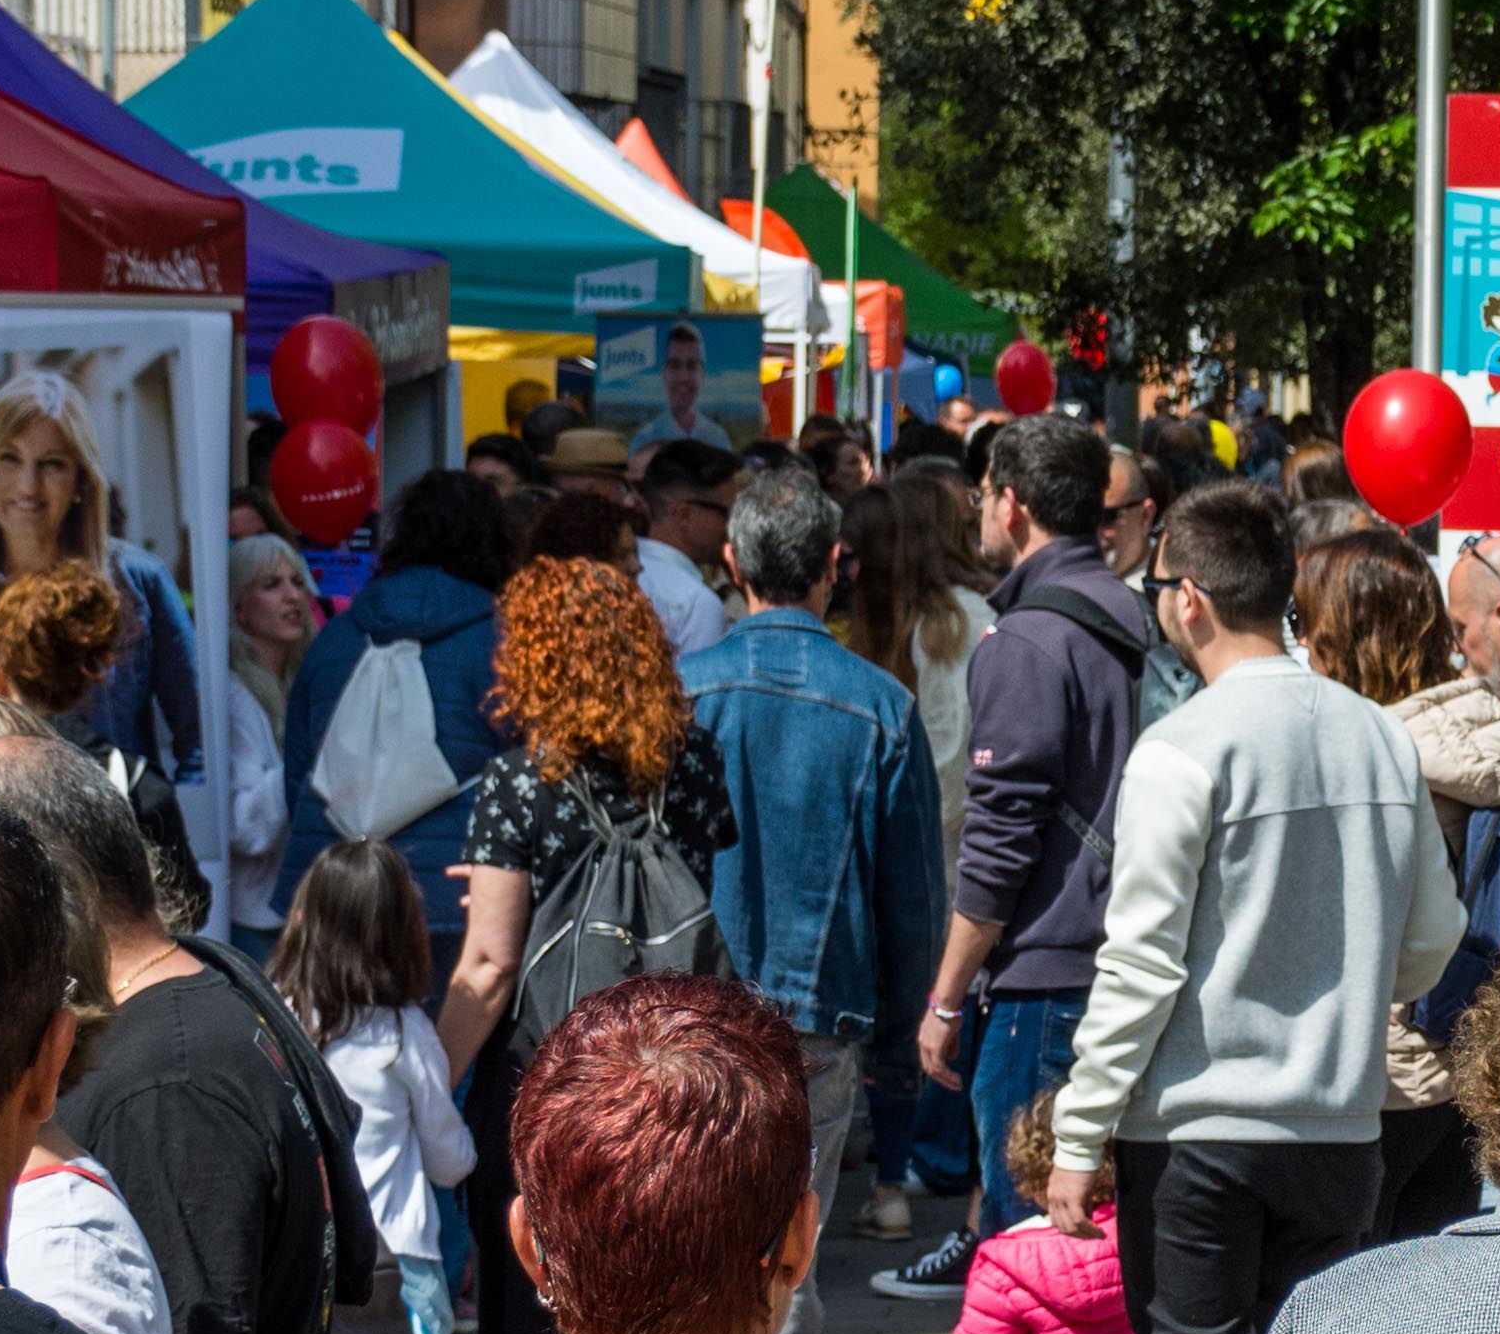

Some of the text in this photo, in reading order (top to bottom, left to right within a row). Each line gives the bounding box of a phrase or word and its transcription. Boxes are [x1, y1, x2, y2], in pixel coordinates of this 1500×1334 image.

[194, 153, 361, 186] unts
[580, 277, 643, 301] junts
[605, 344, 647, 368] junts
